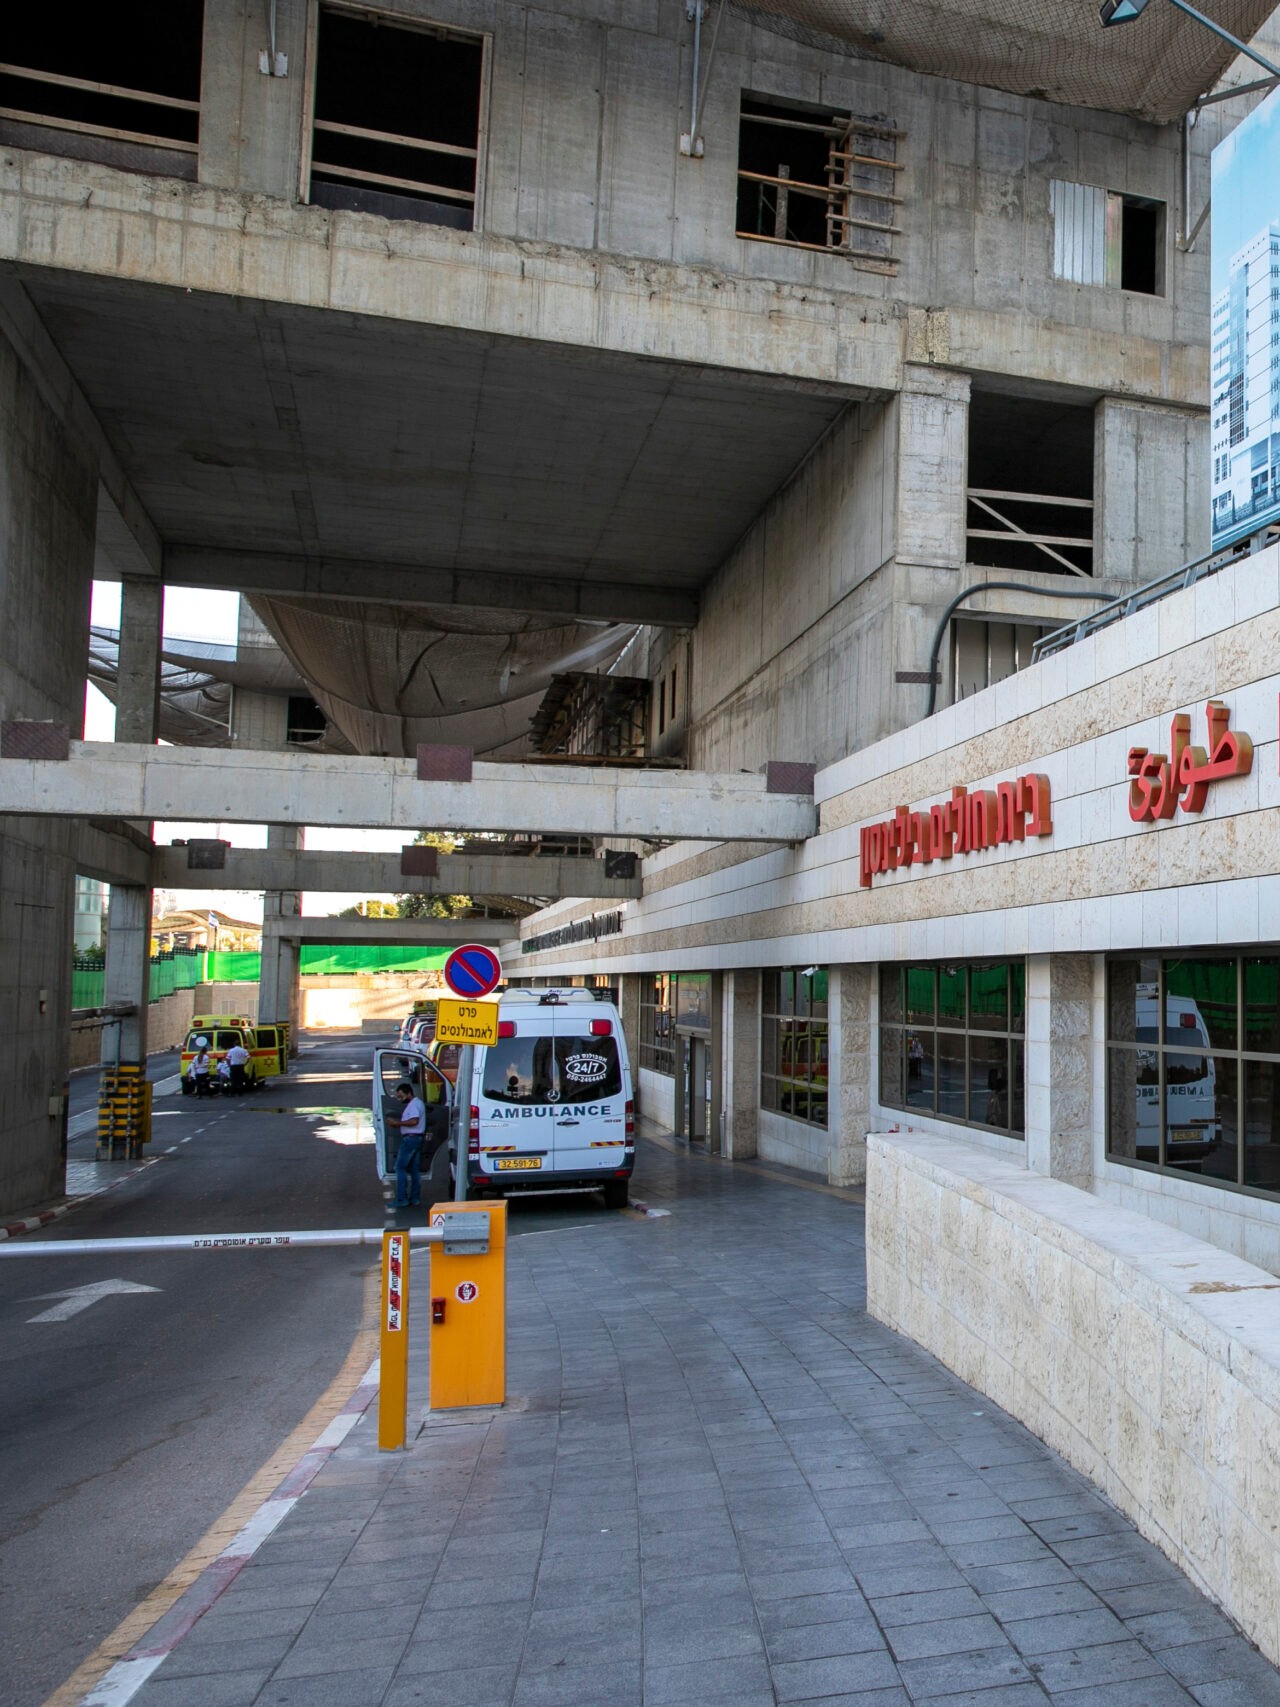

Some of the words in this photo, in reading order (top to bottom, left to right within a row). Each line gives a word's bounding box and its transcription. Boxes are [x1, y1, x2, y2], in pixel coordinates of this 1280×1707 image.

[1128, 701, 1254, 822] طوارئ
[930, 786, 998, 859] חולים
[997, 773, 1053, 843] בית
[860, 805, 933, 888] בילינסון
[440, 1023, 493, 1040] לאמבולנסים
[459, 1006, 477, 1018] פרט
[573, 1061, 599, 1074] 24/7
[491, 1105, 612, 1119] AMBULANCE
